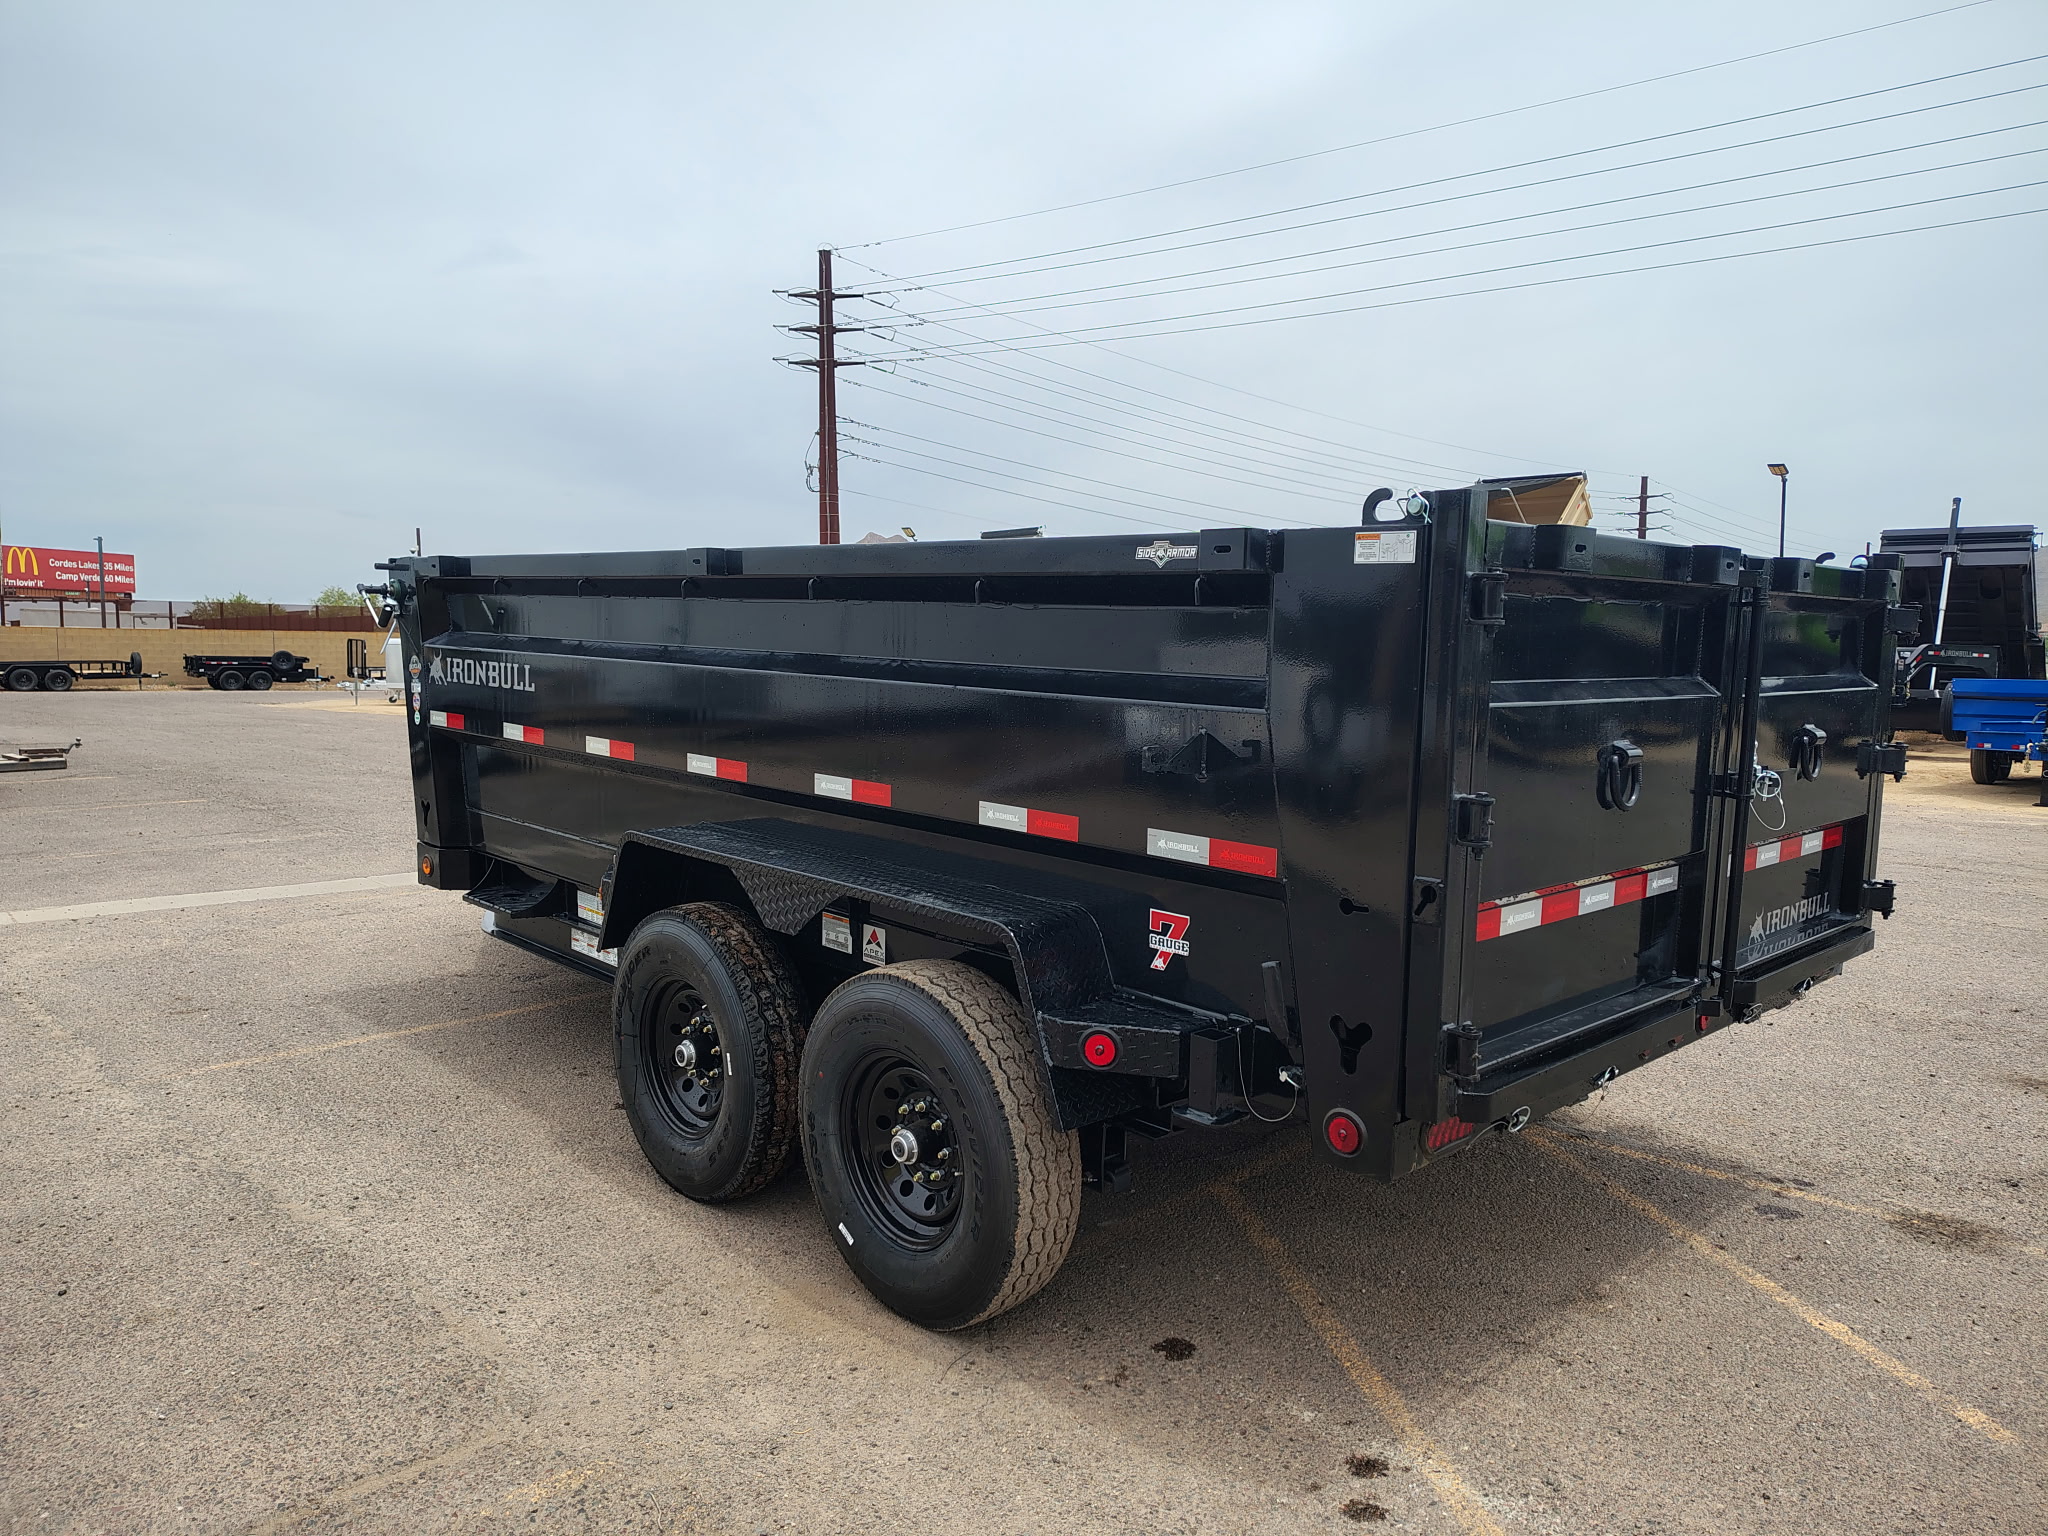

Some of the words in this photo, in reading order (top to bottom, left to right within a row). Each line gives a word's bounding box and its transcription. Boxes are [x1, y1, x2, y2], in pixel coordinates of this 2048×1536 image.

[1137, 548, 1156, 558] SIDE
[1166, 547, 1196, 558] ARMOR
[49, 558, 78, 569] Cordes
[103, 562, 113, 571] 35
[114, 562, 134, 572] Miles
[55, 571, 79, 583] Camp
[79, 572, 101, 582] Verde
[104, 574, 114, 583] 60
[115, 574, 135, 584] Miles
[1946, 650, 1973, 658] IRONBULL
[446, 657, 536, 692] IRONBULL
[1167, 840, 1200, 854] IRONBULL
[1765, 891, 1831, 936] IRONBULL
[1149, 908, 1190, 972] 7
[1150, 934, 1189, 953] GAUGE
[863, 946, 885, 958] APEX
